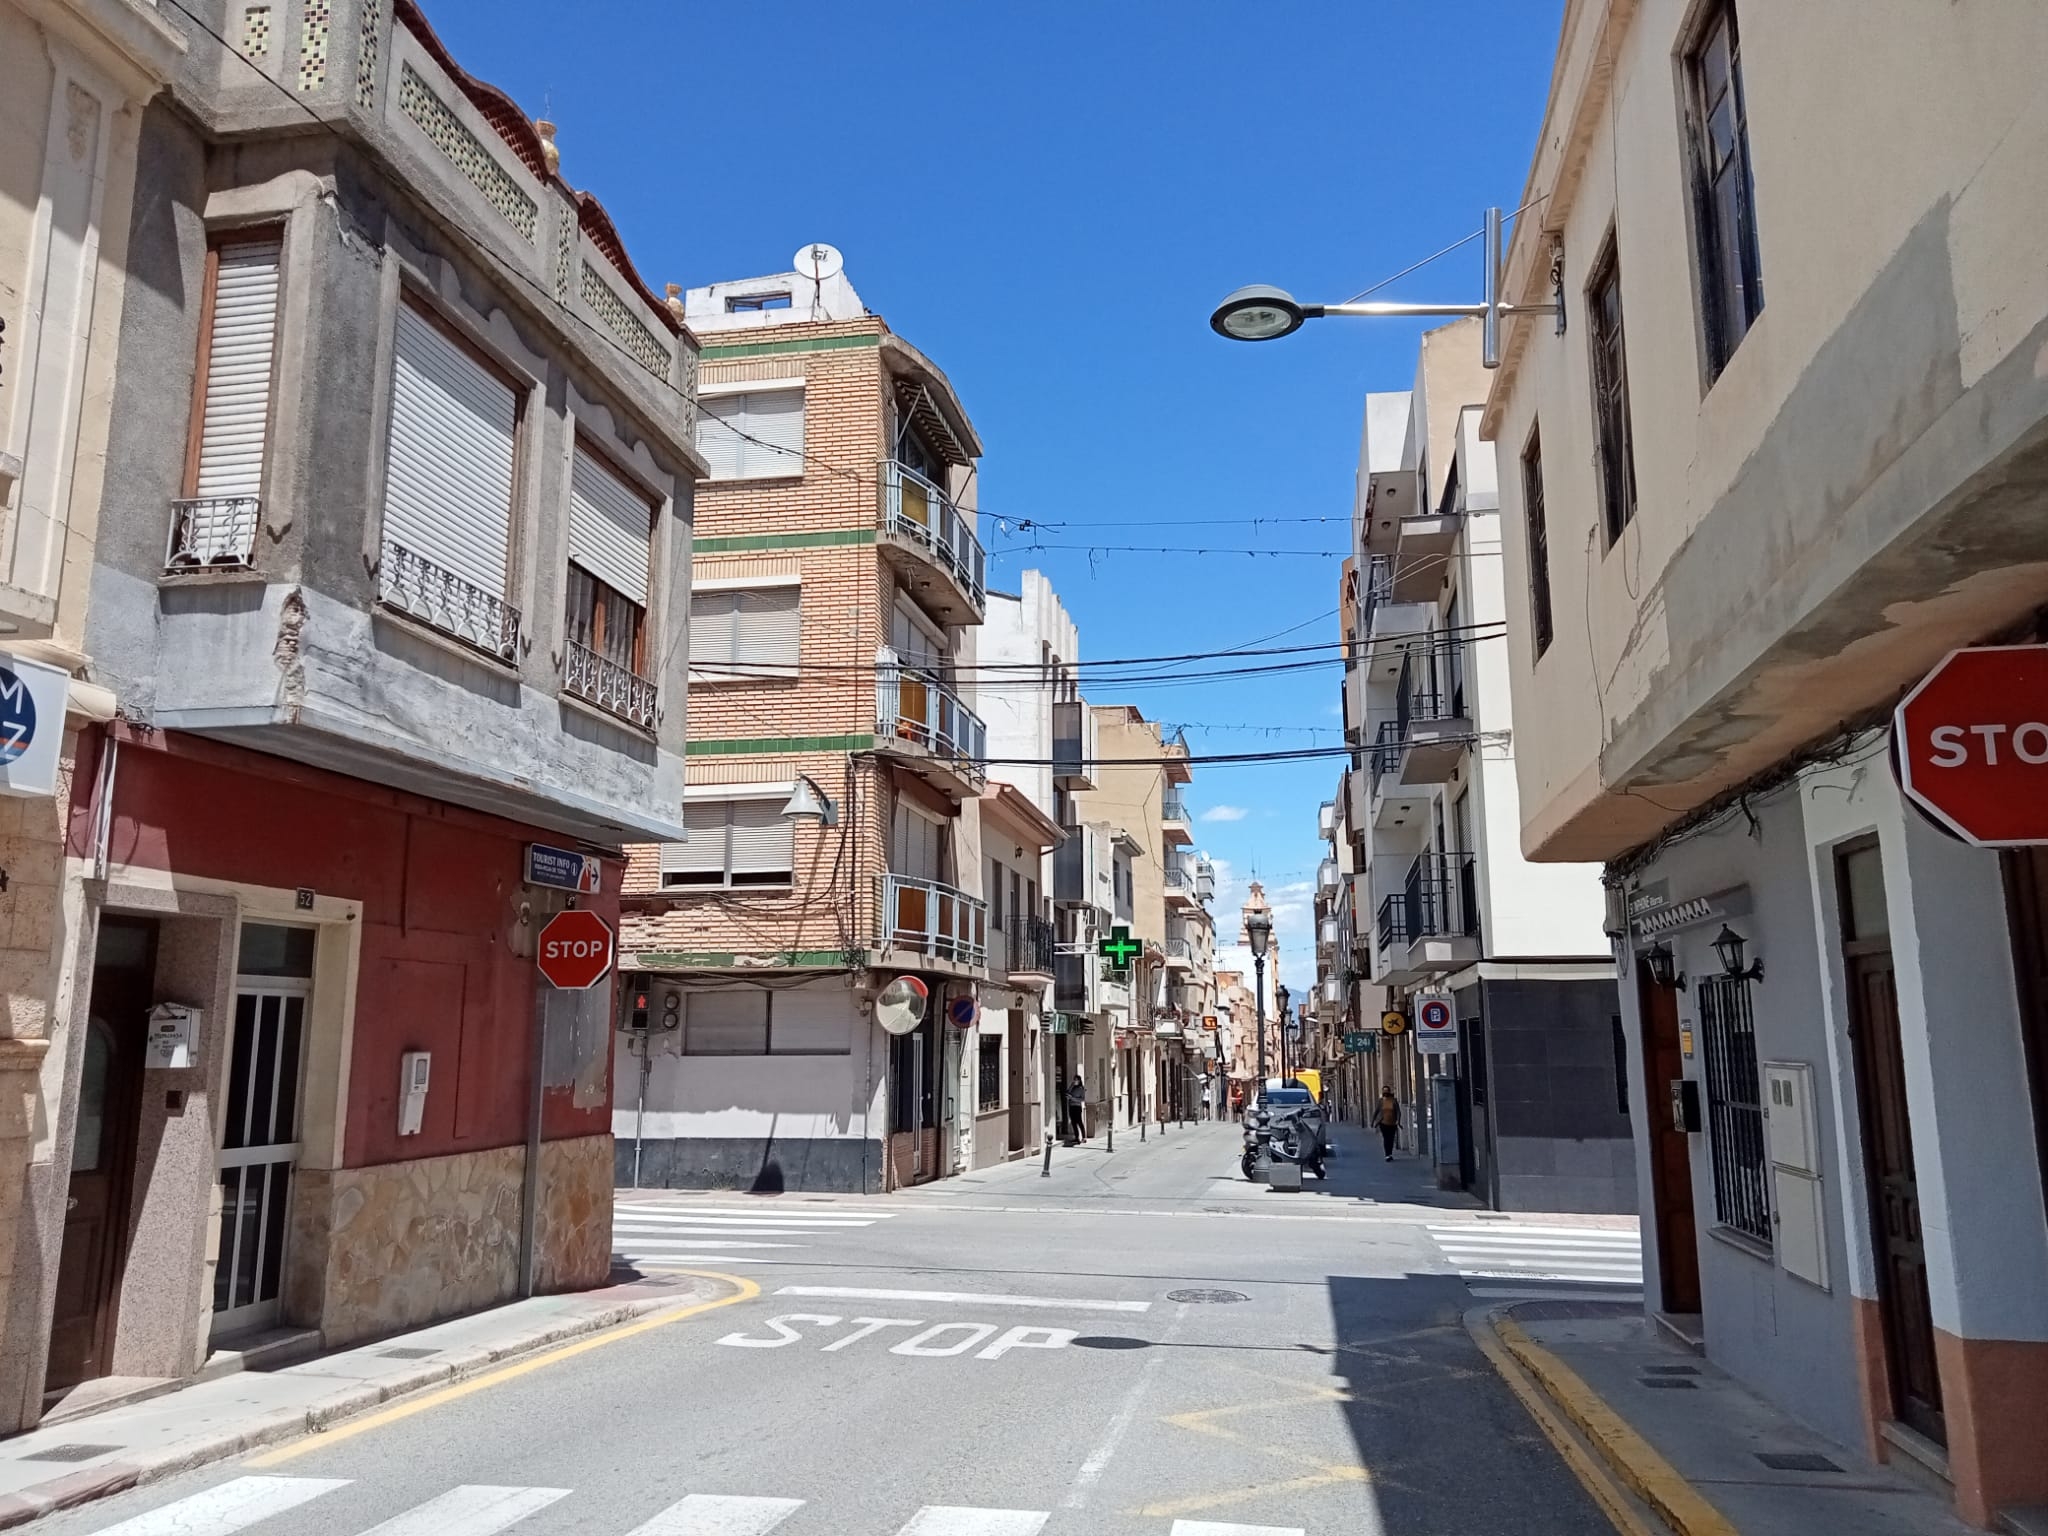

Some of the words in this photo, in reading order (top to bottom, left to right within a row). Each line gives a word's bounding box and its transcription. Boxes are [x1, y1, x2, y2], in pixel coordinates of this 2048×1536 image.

[533, 852, 557, 866] TOURIST
[556, 857, 570, 869] INFO
[545, 940, 603, 958] STOP
[713, 1313, 1081, 1360] STOP
